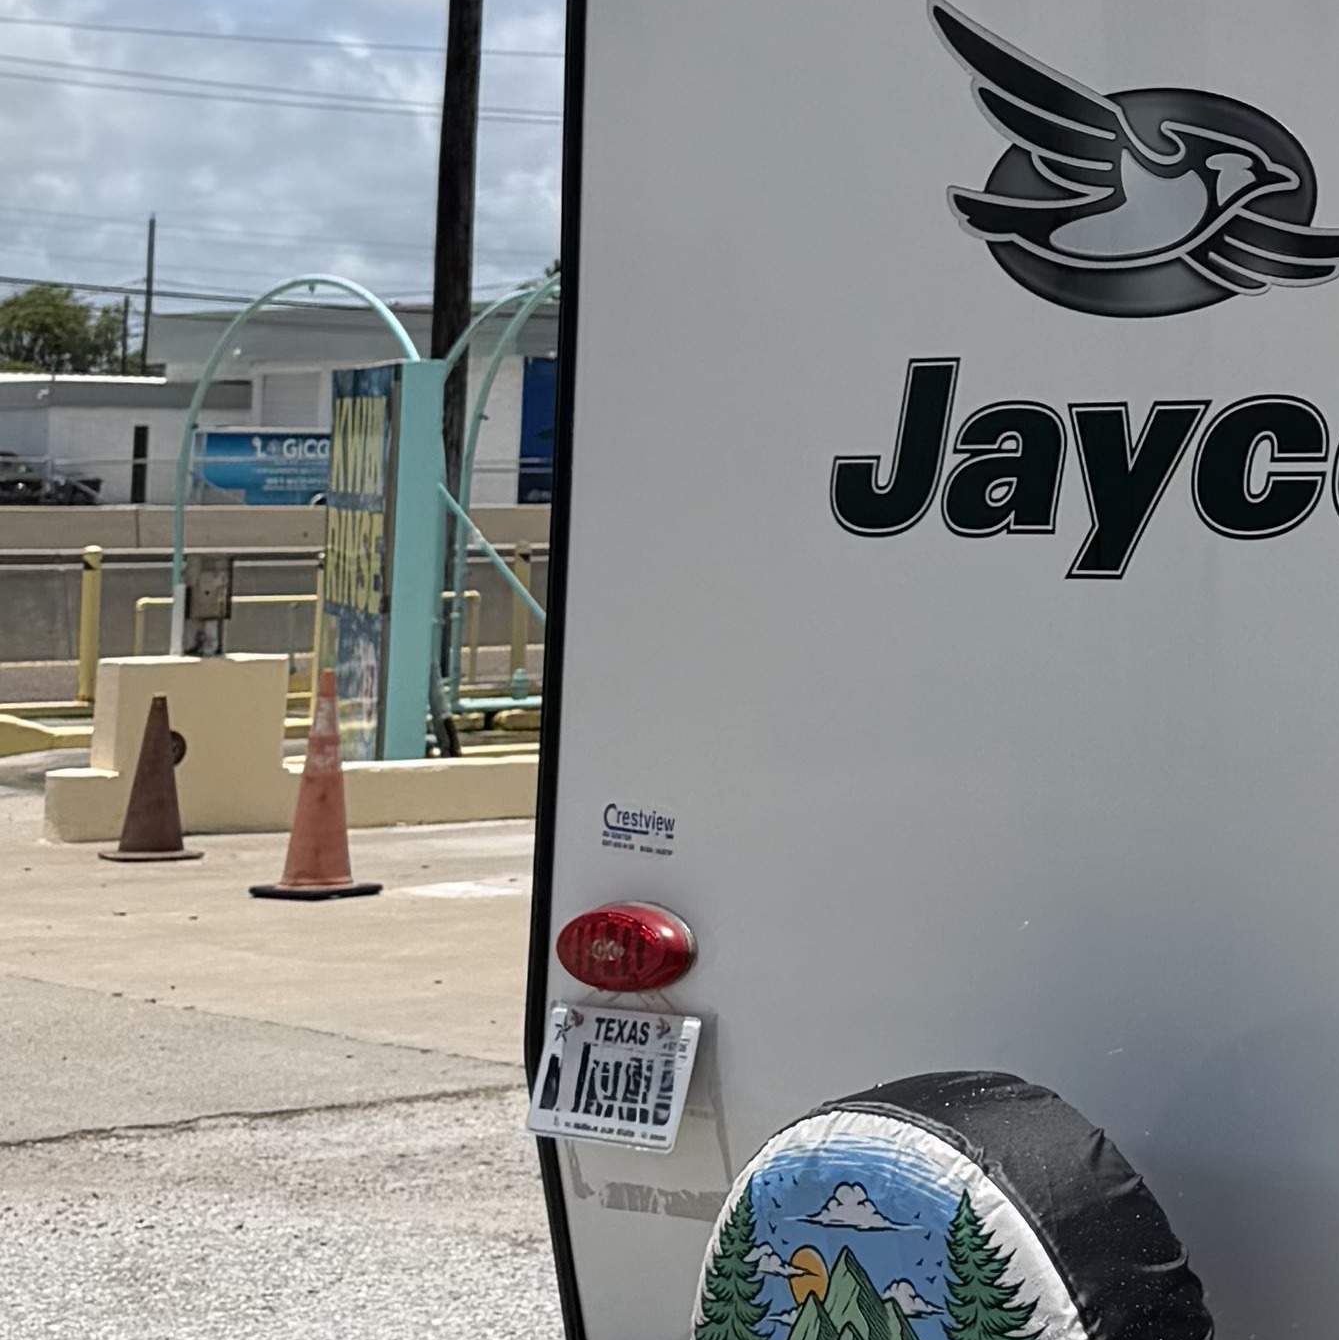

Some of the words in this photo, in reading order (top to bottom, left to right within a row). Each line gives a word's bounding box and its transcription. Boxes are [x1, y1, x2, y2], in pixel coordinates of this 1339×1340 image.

[325, 507, 385, 614] RINSE
[603, 803, 675, 835] Crestview
[594, 1016, 651, 1046] TEXAS
